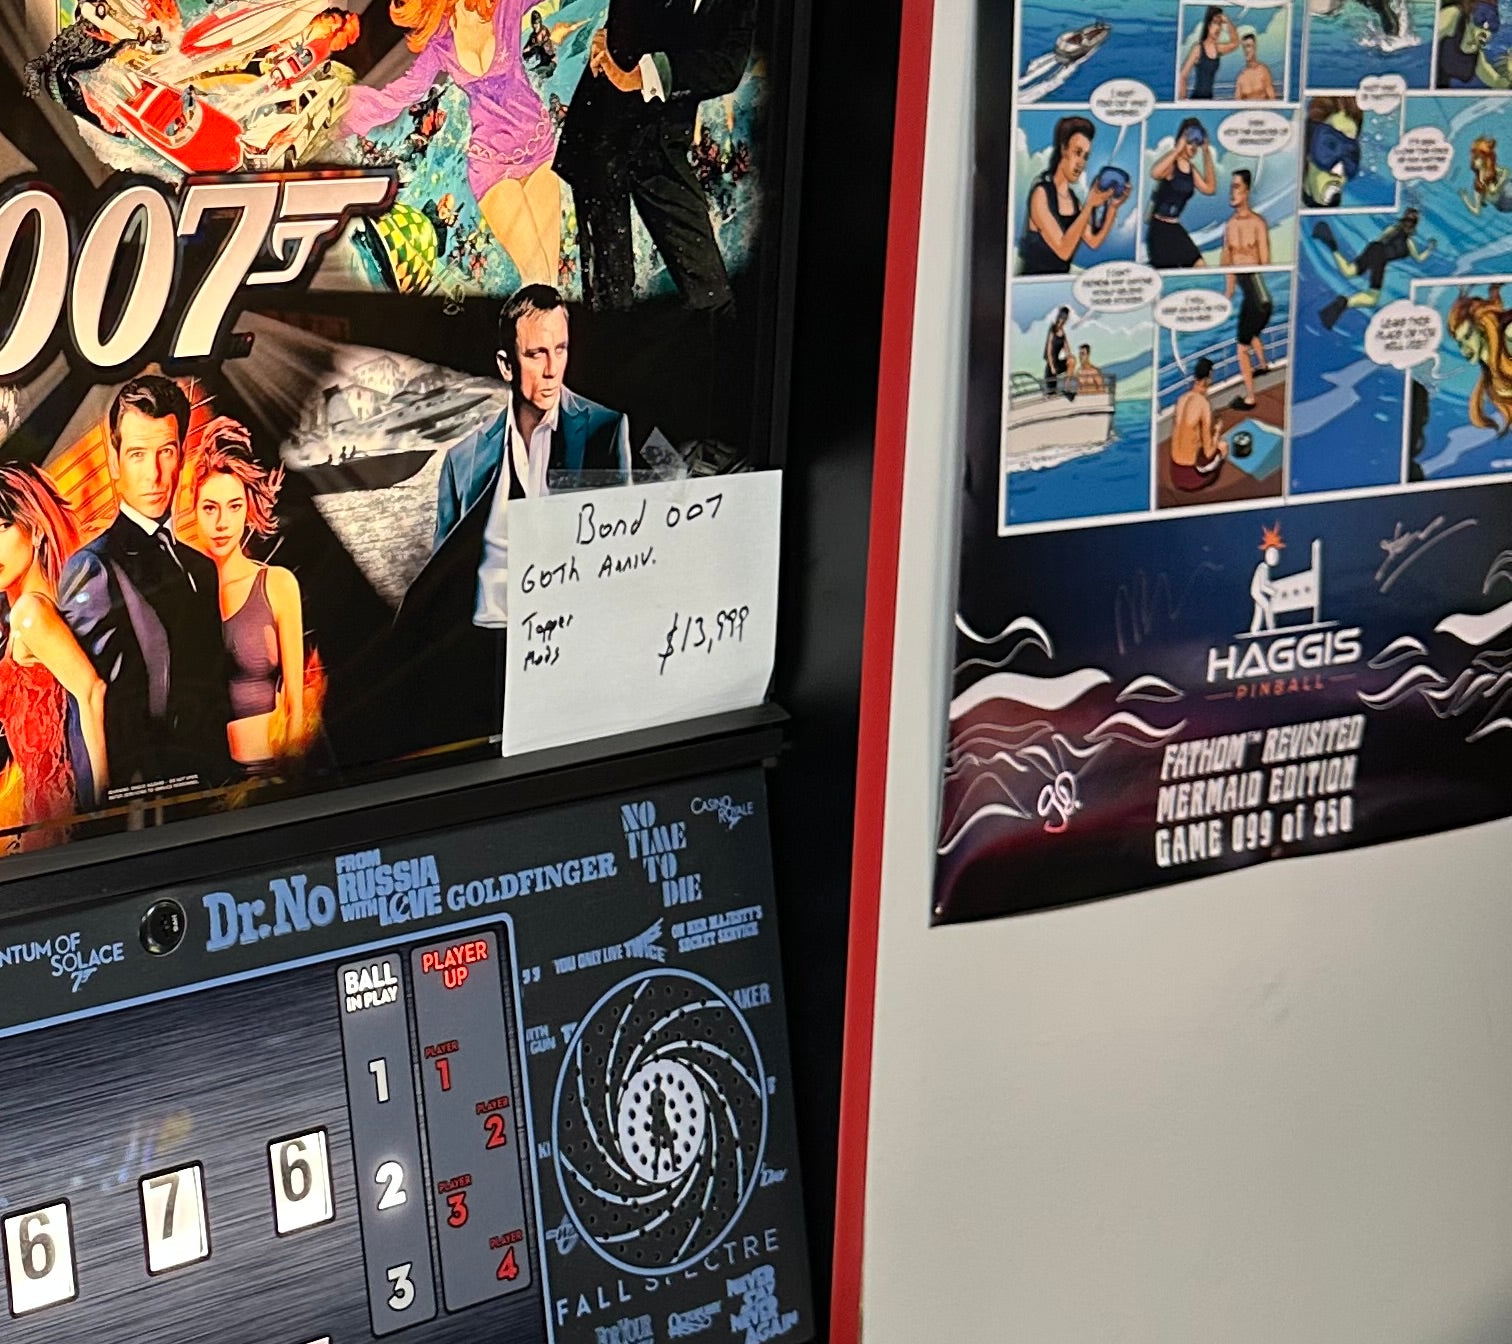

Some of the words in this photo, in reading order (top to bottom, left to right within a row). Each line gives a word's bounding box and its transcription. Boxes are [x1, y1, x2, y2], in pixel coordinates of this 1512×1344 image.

[576, 499, 647, 544] Bond
[666, 494, 723, 528] 007
[658, 605, 748, 675] $13,999
[1205, 626, 1362, 683] HAGGIS
[1236, 673, 1324, 700] PINBALL
[1262, 714, 1365, 765] REVISITED
[1156, 766, 1262, 824] MERMAID
[1269, 755, 1358, 804] EDITION
[621, 800, 656, 833] NO
[1155, 819, 1221, 868] GAME
[1231, 810, 1273, 855] 099
[1281, 806, 1306, 842] of
[1313, 797, 1354, 838] 250
[335, 848, 381, 875] FROM
[337, 855, 440, 907] RUSSIA
[446, 851, 618, 914] GOLDFINGER
[339, 898, 379, 924] WITH
[377, 886, 443, 927] LOVE
[50, 942, 124, 976] SOLACE
[56, 932, 80, 954] OF
[423, 941, 488, 972] PLAYER
[345, 962, 397, 996] BALL
[443, 967, 469, 988] UP
[346, 994, 362, 1012] IN
[362, 987, 398, 1009] PLAY
[425, 1040, 458, 1058] PLAYER
[369, 1059, 389, 1103] 1
[436, 1059, 452, 1091] 1
[476, 1097, 510, 1114] PLAYER
[485, 1115, 507, 1150] 2
[375, 1161, 407, 1211] 2
[438, 1175, 472, 1194] PLAYER
[19, 1213, 56, 1280] 6
[149, 1175, 180, 1240] 7
[279, 1140, 313, 1202] 6
[448, 1193, 468, 1228] 3
[490, 1230, 523, 1248] PLAYER
[496, 1248, 520, 1281] 4
[387, 1263, 415, 1311] 3
